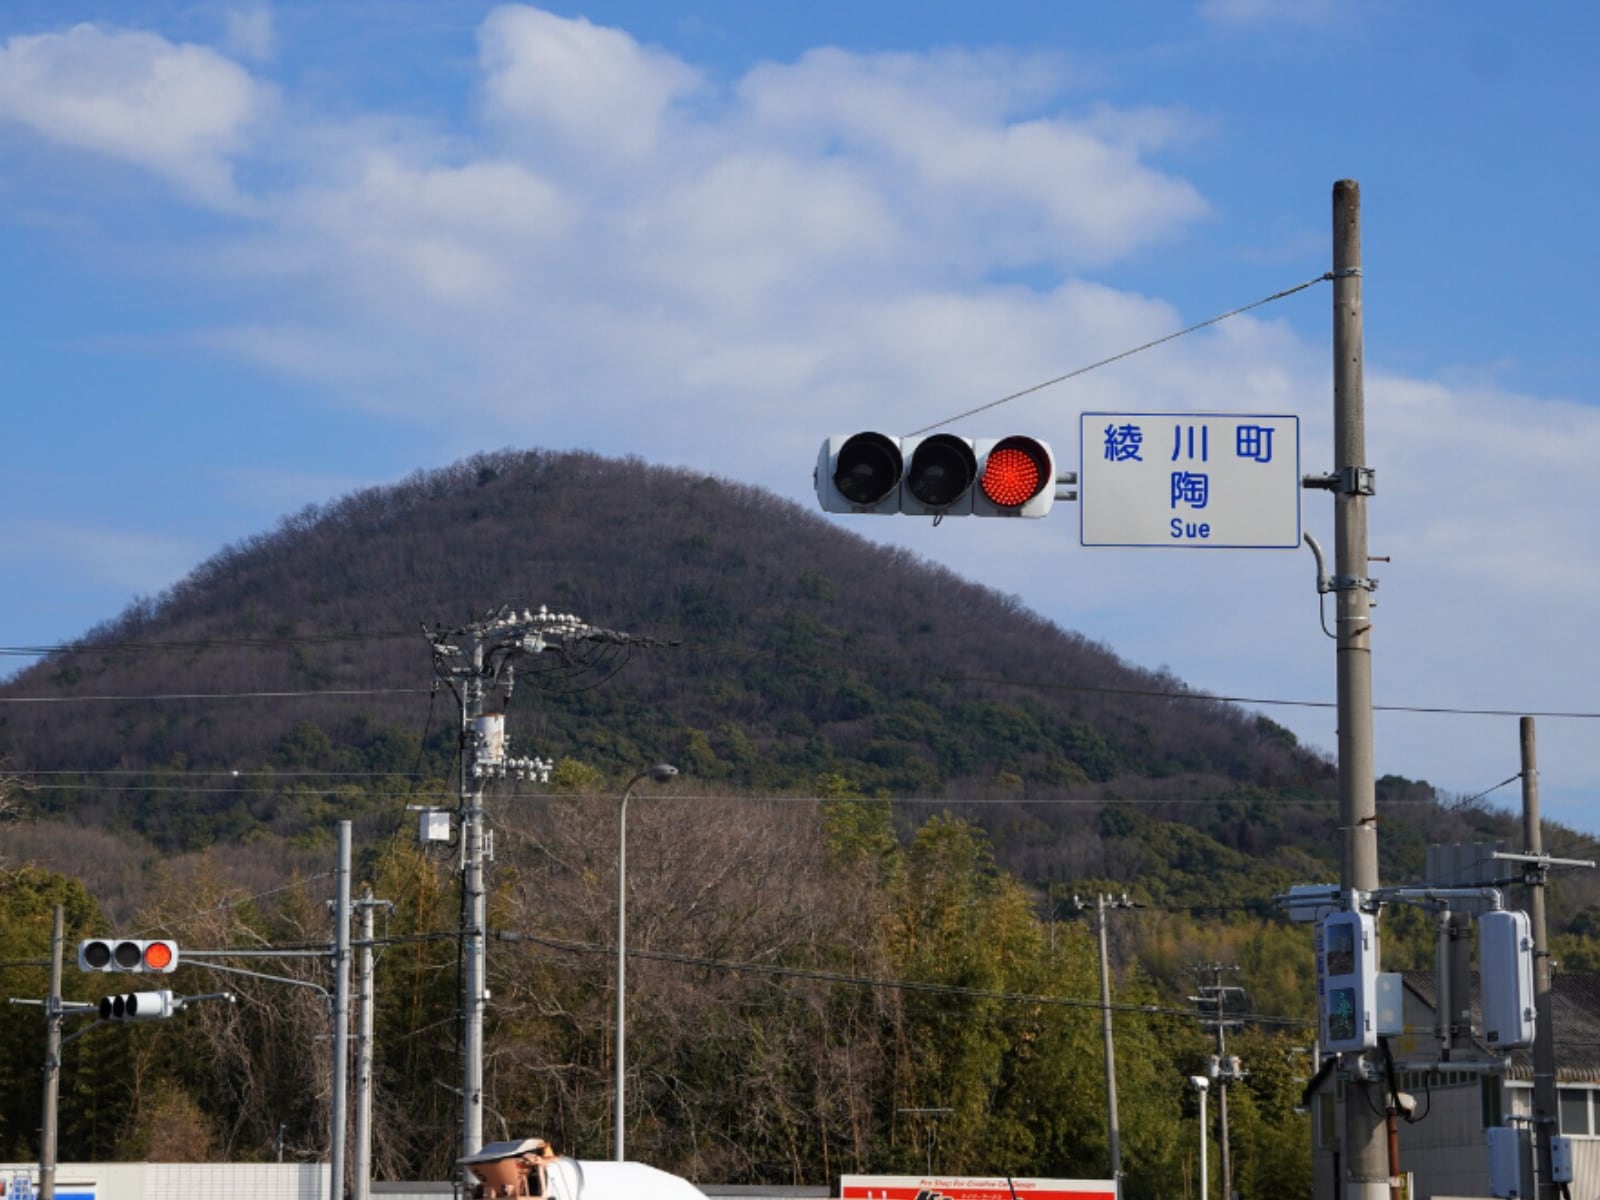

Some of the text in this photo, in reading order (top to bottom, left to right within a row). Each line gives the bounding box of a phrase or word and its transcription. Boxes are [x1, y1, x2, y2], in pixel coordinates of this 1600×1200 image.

[1104, 423, 1275, 463] 綾川町
[1171, 471, 1208, 509] 陶
[1170, 518, 1211, 538] Sue
